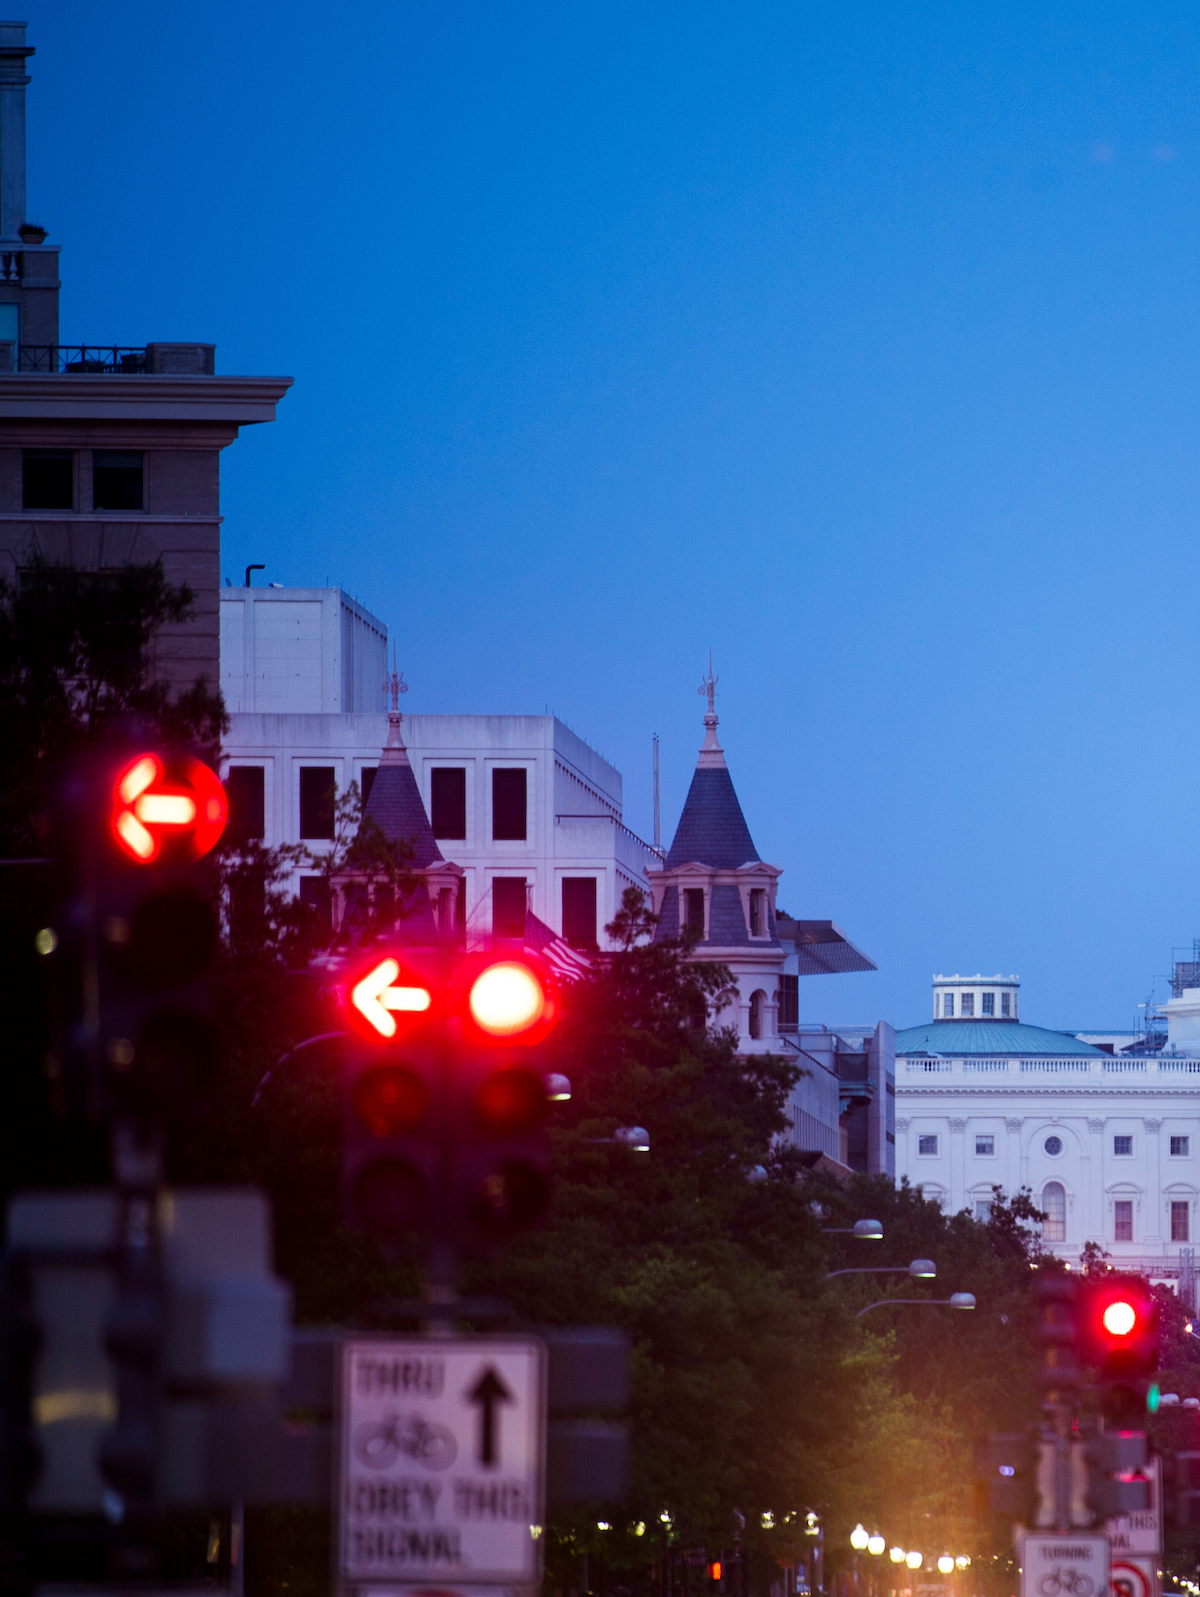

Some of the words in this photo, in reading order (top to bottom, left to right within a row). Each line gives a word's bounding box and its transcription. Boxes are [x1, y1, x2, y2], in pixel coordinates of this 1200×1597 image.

[355, 1358, 446, 1397] THRU
[353, 1480, 442, 1520] OBEY
[453, 1480, 532, 1521] THIS
[1128, 1515, 1157, 1530] THIS
[353, 1526, 462, 1563] SIGNAL
